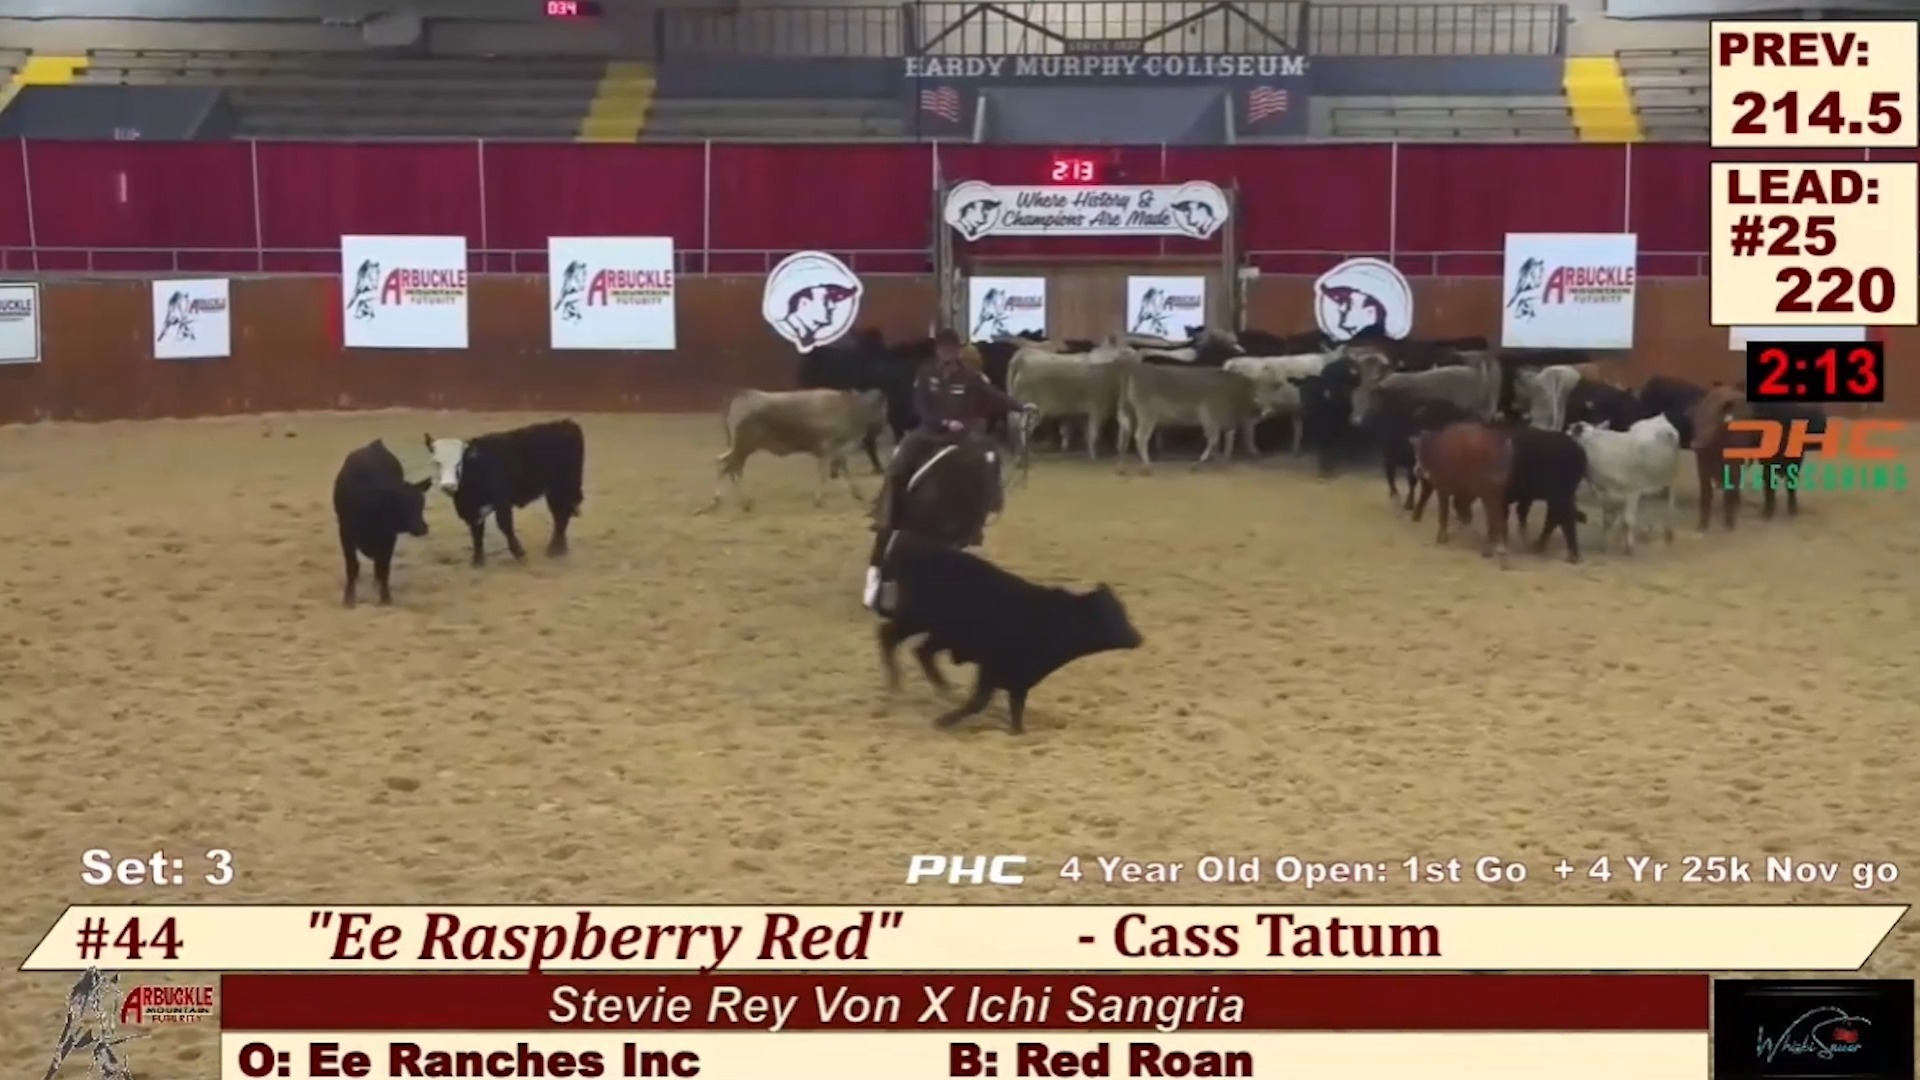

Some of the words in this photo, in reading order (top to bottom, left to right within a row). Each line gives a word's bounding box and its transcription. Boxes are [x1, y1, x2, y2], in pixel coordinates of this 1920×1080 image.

[905, 56, 1005, 77] HARDY
[1015, 56, 1140, 76] MURPHY
[1145, 55, 1306, 76] COLISEUM
[1016, 190, 1067, 208] Where
[1073, 190, 1131, 212] History
[1137, 189, 1154, 209] &
[1001, 211, 1085, 230] Champions
[1089, 211, 1121, 227] Are
[1125, 208, 1172, 227] Made
[380, 267, 467, 306] ARBUCKLE
[586, 268, 673, 307] ARBUCKLE
[1541, 265, 1635, 305] ARBUCKLE
